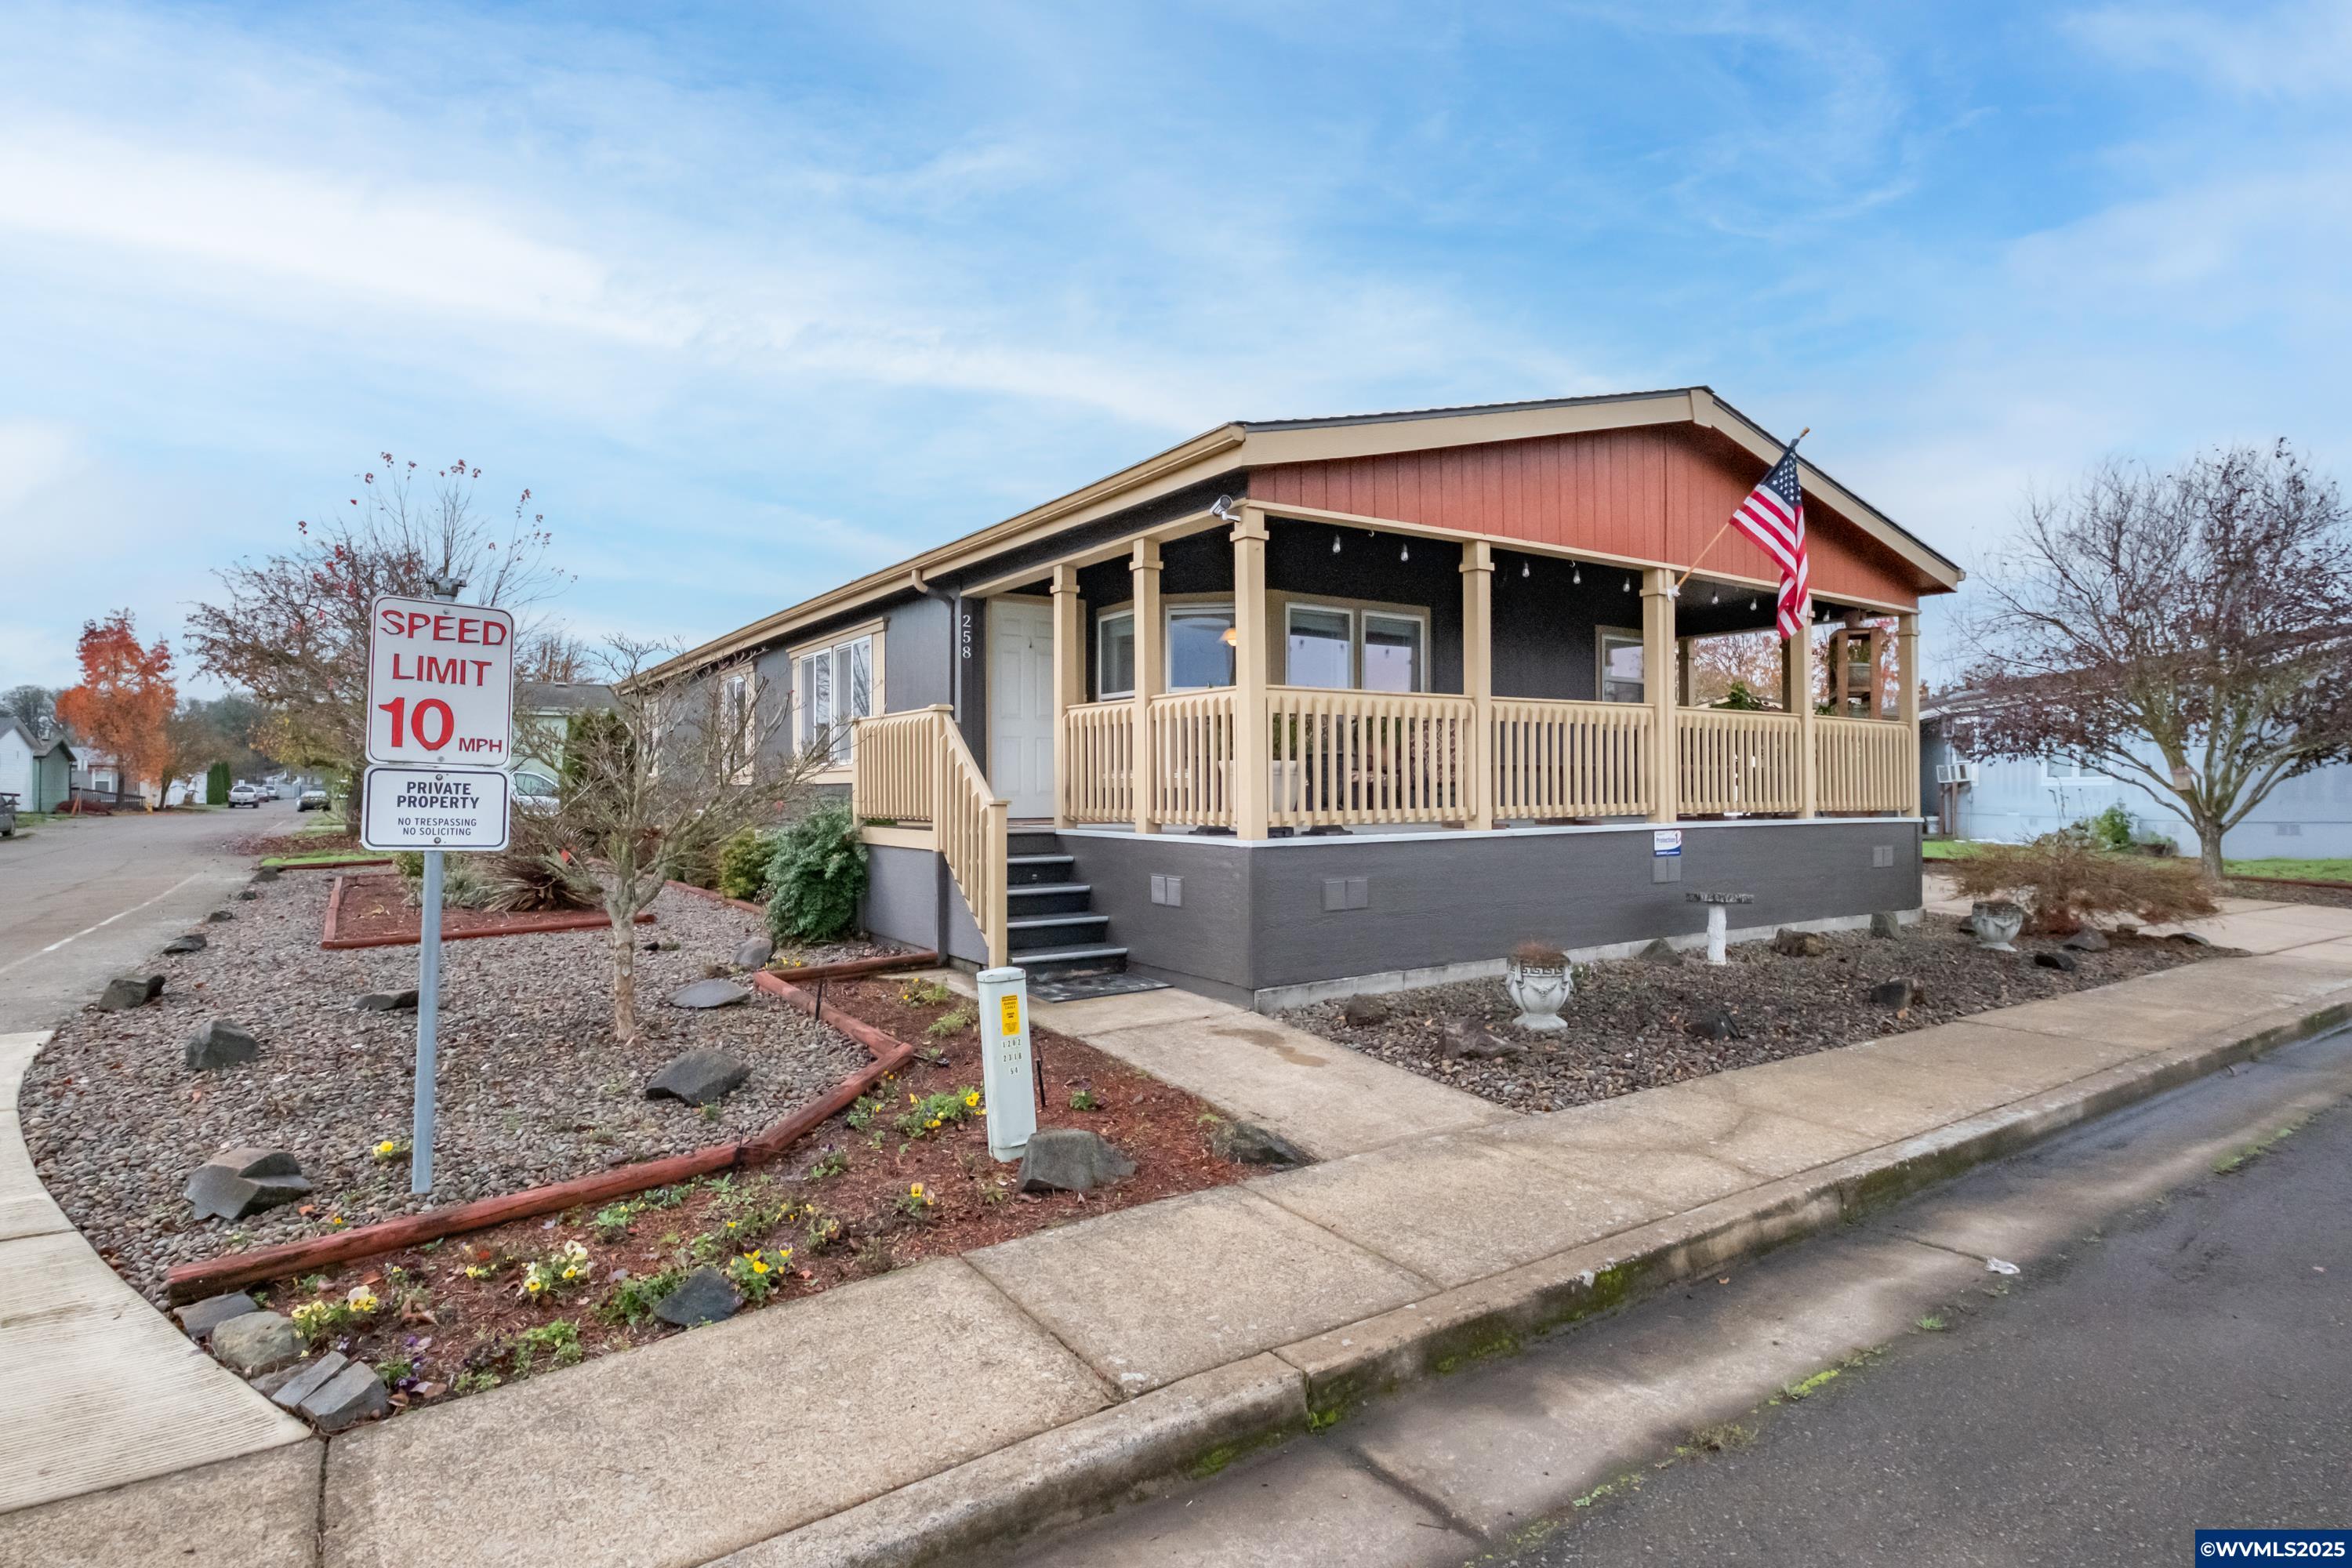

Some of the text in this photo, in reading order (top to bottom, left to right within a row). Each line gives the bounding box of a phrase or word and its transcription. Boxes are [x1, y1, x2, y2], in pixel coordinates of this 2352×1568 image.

[380, 610, 507, 646] SPEED
[962, 615, 971, 659] 258
[393, 653, 492, 686] LIMIT
[378, 697, 503, 753] 10 MPH
[406, 782, 471, 795] PRIVATE
[397, 796, 480, 809] PROPERTY
[403, 827, 471, 837] NO SOLICITING
[415, 818, 477, 827] TRESPASSING
